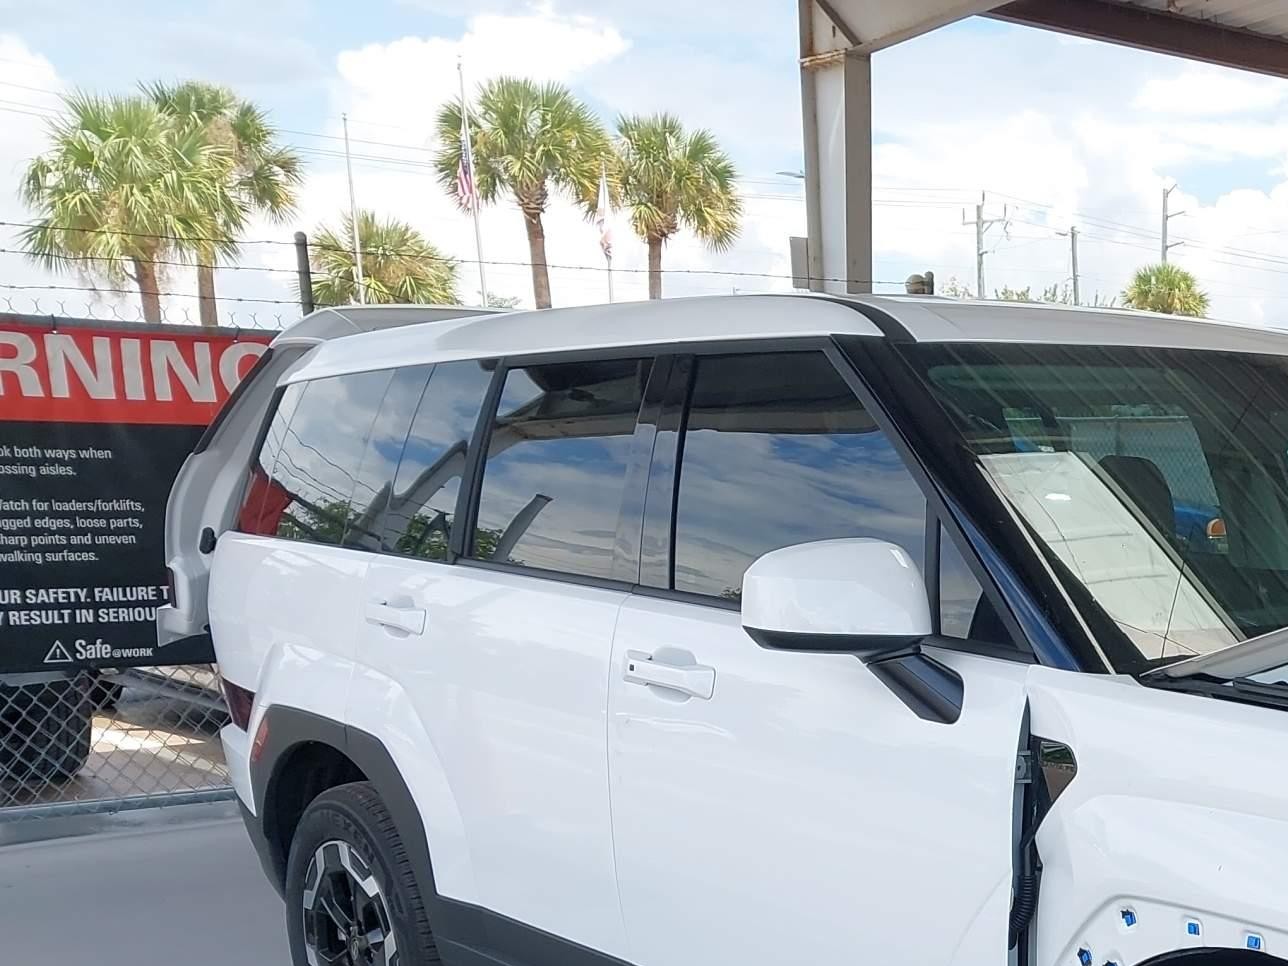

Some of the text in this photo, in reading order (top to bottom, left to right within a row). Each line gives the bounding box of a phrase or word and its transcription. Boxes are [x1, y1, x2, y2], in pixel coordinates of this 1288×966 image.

[13, 445, 42, 458] both
[44, 449, 77, 461] ways
[79, 448, 112, 459] when
[39, 464, 77, 476] aisles.
[0, 499, 145, 513] atch for loaders/forklifts,
[0, 516, 143, 531] gged edges, loose parts,
[31, 533, 67, 547] points
[70, 533, 92, 545] and
[95, 535, 136, 545] uneven
[45, 550, 99, 562] surfaces.
[25, 588, 91, 604] SAFETY.
[94, 586, 157, 602] FAILURE
[8, 609, 72, 625] RESULT
[76, 608, 94, 623] IN
